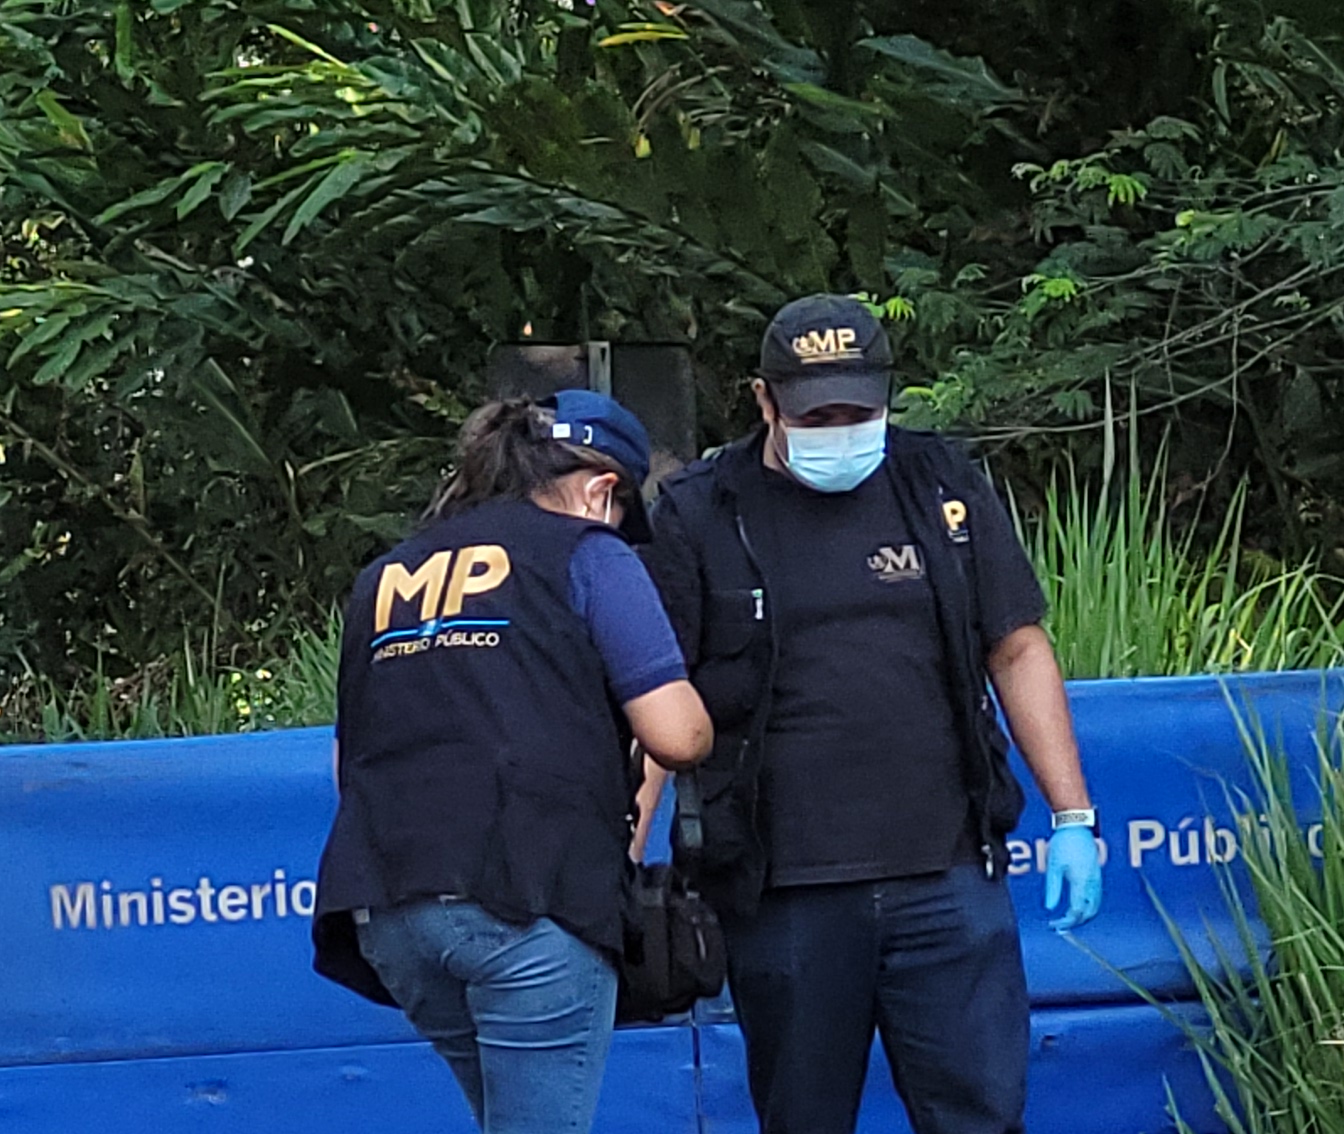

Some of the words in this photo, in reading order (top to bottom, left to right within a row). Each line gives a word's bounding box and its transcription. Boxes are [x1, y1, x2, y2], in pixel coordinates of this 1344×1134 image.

[808, 327, 856, 354] MP
[942, 500, 967, 531] P
[878, 544, 925, 574] M
[375, 544, 511, 632] MP
[49, 868, 316, 930] Ministerio
